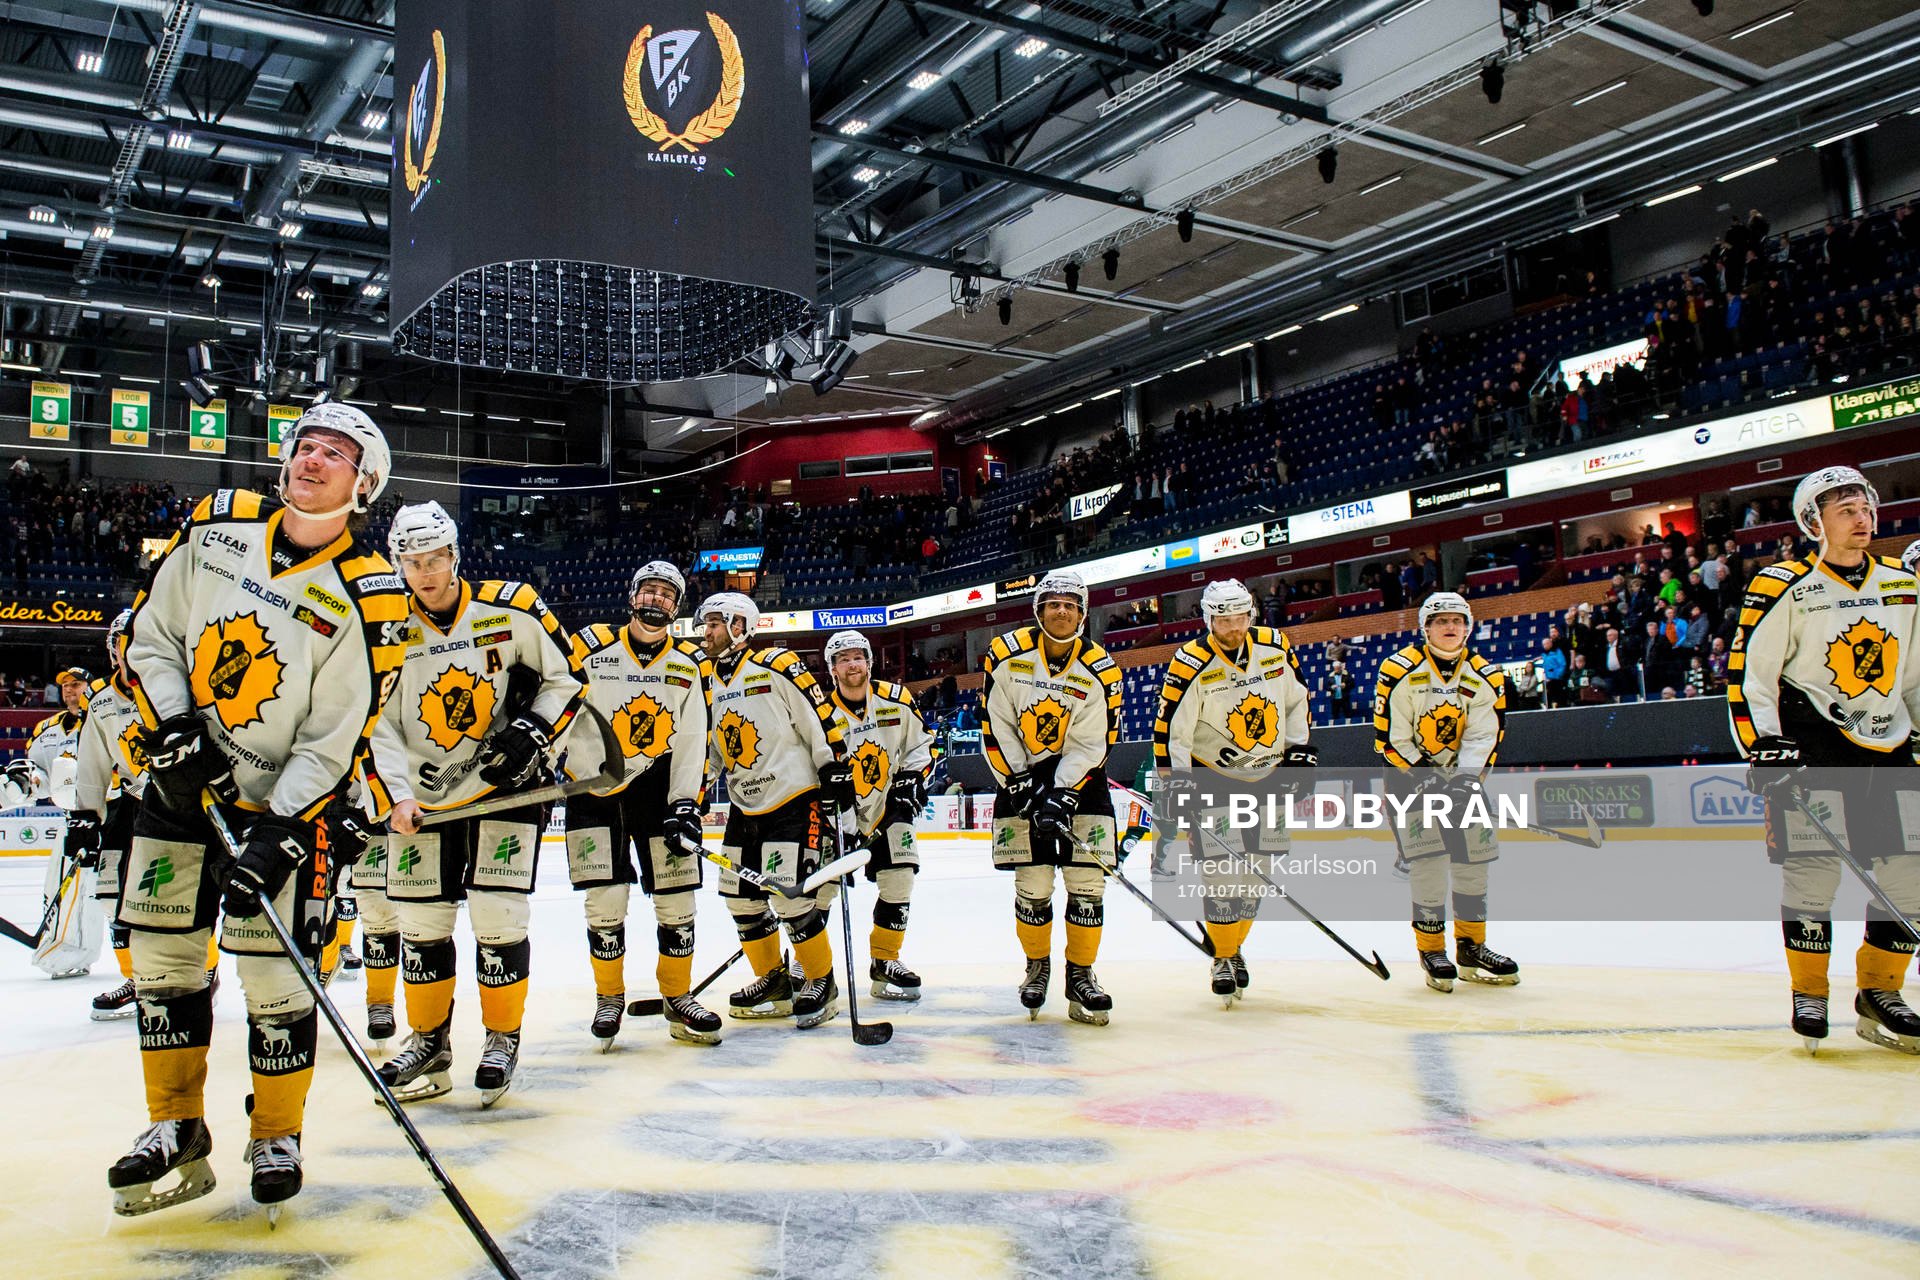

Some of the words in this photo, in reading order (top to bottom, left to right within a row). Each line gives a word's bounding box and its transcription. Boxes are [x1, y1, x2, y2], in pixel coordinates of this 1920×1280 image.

[1834, 383, 1899, 411] klaravik
[41, 399, 59, 421] 9
[122, 406, 138, 428] 5
[200, 414, 216, 435] 2
[1332, 500, 1375, 522] STENA
[241, 577, 291, 611] BOLIDEN
[307, 584, 347, 613] engcon
[1838, 598, 1879, 609] BOLIDEN
[0, 601, 46, 619] den
[47, 601, 104, 622] Star
[473, 615, 507, 630] engcon
[429, 639, 470, 656] BOLIDEN
[486, 647, 503, 676] A
[666, 662, 694, 675] engcon
[626, 674, 661, 683] BOLIDEN
[1543, 783, 1641, 803] GRÖNSAKS
[1569, 803, 1628, 820] HUSET
[354, 871, 387, 879] martins
[125, 899, 191, 914] martinsons
[223, 925, 278, 939] martinson
[252, 1051, 309, 1072] NORRAN
